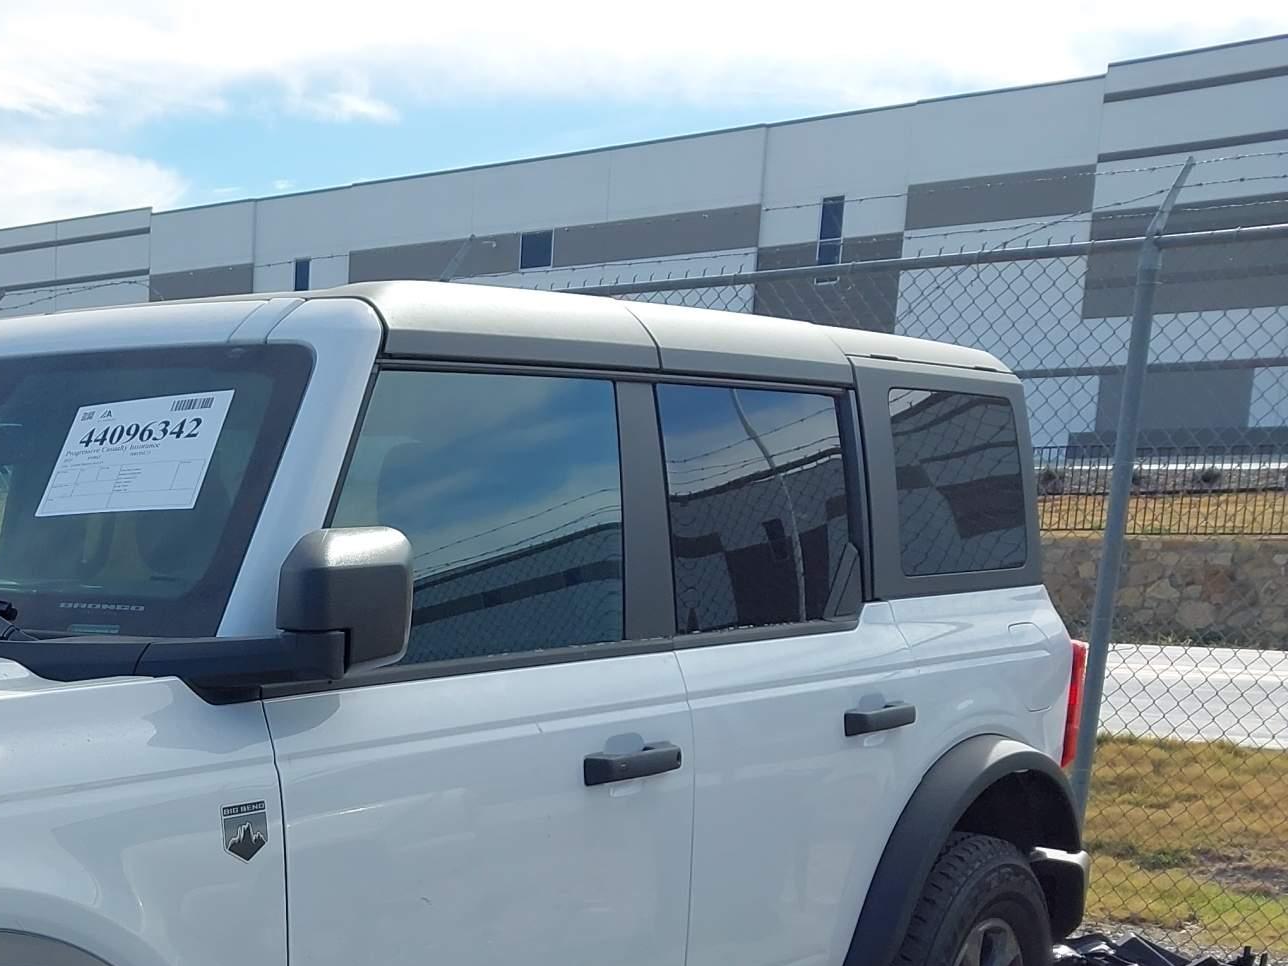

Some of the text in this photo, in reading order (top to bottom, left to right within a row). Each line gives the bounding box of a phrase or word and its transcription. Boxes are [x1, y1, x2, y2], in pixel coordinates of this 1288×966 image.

[79, 417, 203, 448] 44096342
[65, 448, 101, 458] Progressive
[129, 442, 161, 451] Insurance
[223, 802, 265, 815] BIG BEND
